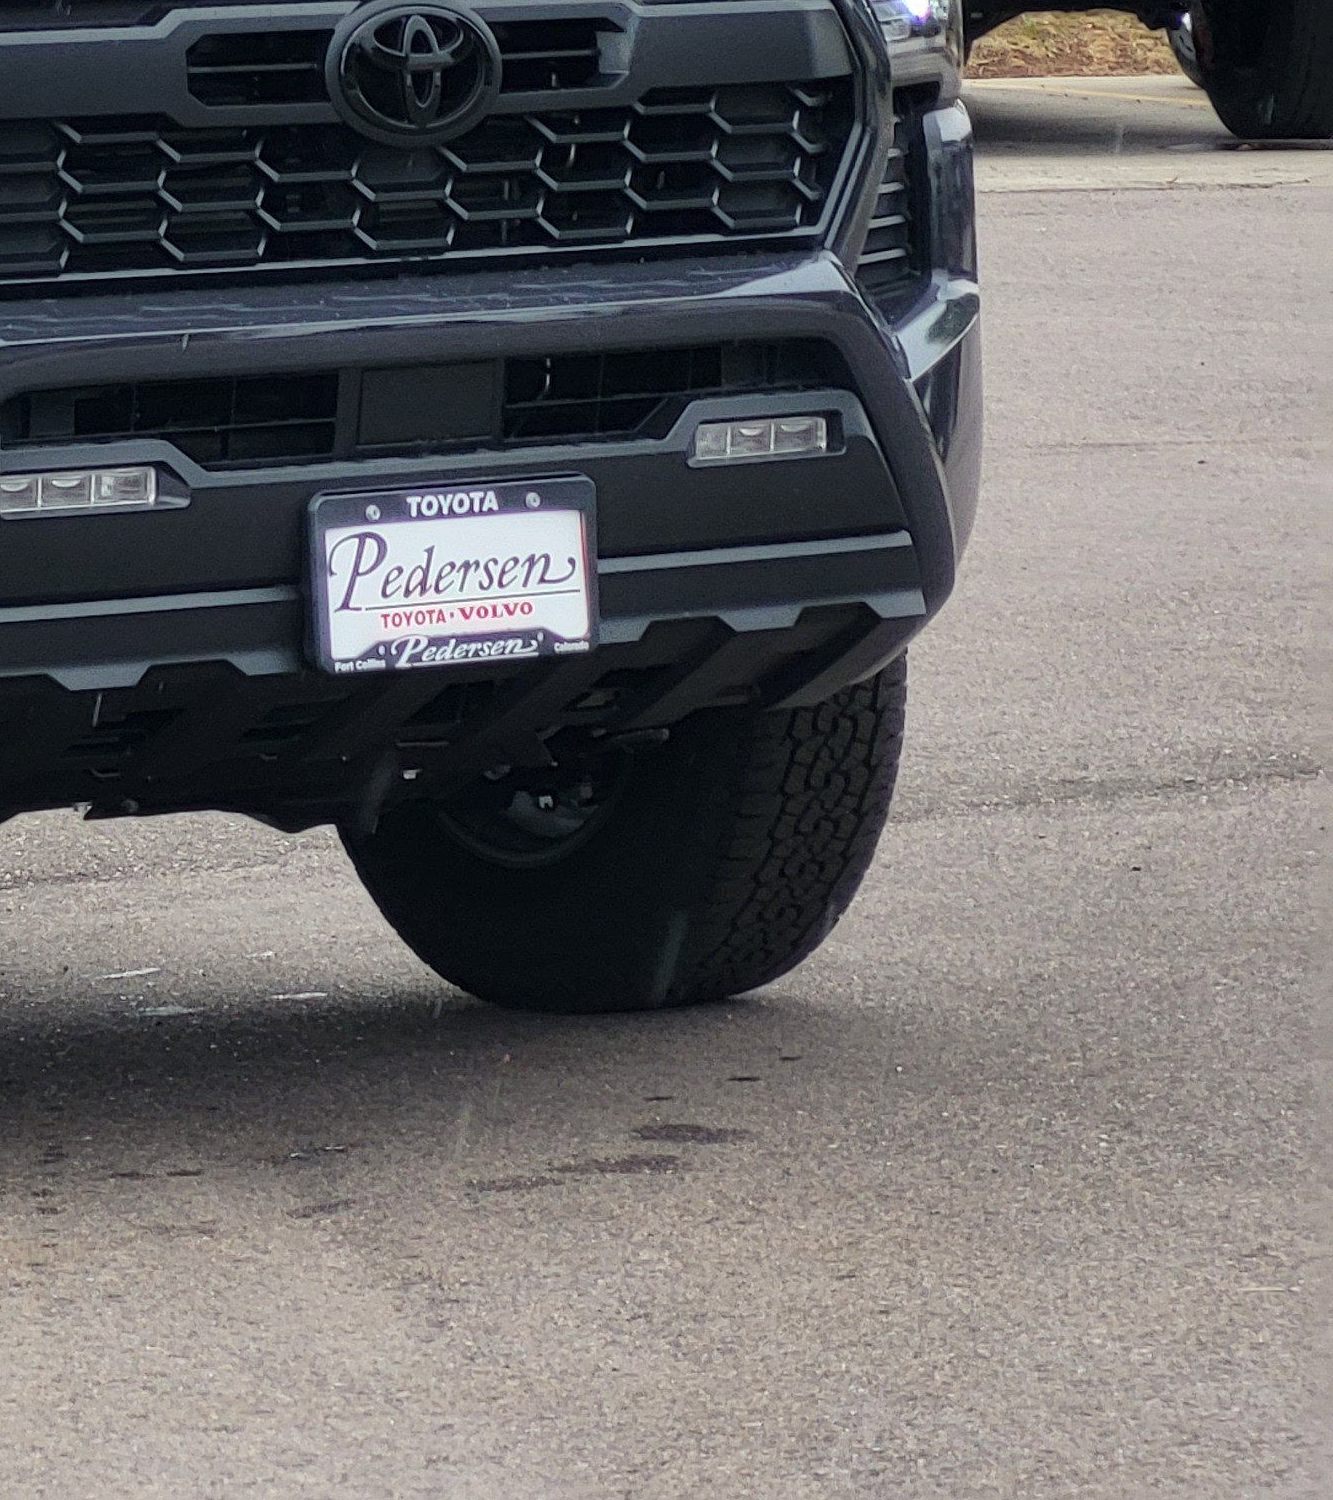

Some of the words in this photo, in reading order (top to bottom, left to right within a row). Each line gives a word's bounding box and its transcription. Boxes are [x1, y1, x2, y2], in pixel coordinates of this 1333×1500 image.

[406, 490, 499, 518] TOYOTA
[329, 531, 576, 613] Pedersen
[380, 608, 447, 629] TOYOTA
[457, 601, 534, 621] VOLVO
[390, 634, 539, 668] Pedersen
[334, 659, 354, 673] Fort
